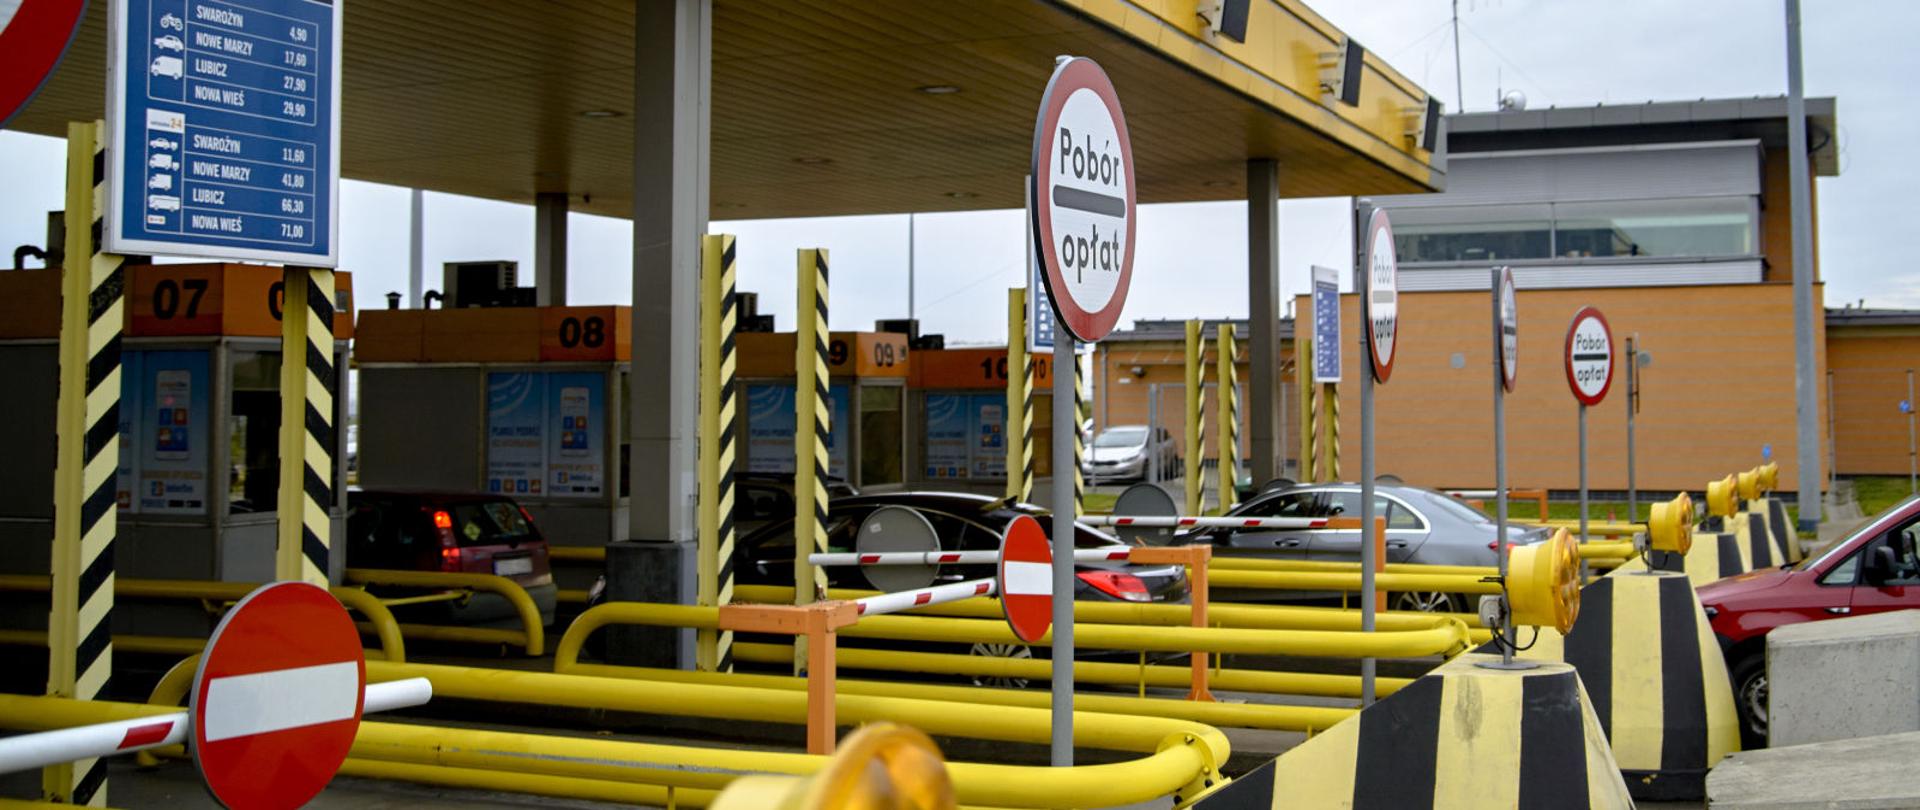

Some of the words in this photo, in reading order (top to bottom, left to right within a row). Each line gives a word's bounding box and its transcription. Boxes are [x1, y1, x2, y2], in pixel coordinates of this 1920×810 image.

[196, 5, 243, 28] SWAROŻYN
[289, 26, 307, 43] 4,90
[196, 32, 222, 50] NOWE
[224, 35, 253, 56] MARZY
[195, 59, 227, 77] LUBICZ
[284, 76, 306, 93] 27,90
[194, 85, 221, 104] NOWA
[223, 88, 245, 106] WIEŚ
[283, 101, 306, 118] 29,90
[193, 133, 240, 154] SWAROŻYN
[1060, 127, 1120, 187] Pobór
[193, 161, 220, 178] NOWE
[221, 163, 251, 182] MARZY
[192, 188, 225, 205] LUBICZ
[192, 214, 219, 230] NOWA
[220, 215, 243, 233] WIEŚ
[281, 223, 304, 239] 71,00
[1062, 224, 1120, 283] opłat
[152, 279, 208, 320] 07
[558, 316, 605, 348] 08
[1576, 333, 1606, 351] Pobór
[874, 342, 895, 368] 09
[1577, 365, 1606, 387] opłat
